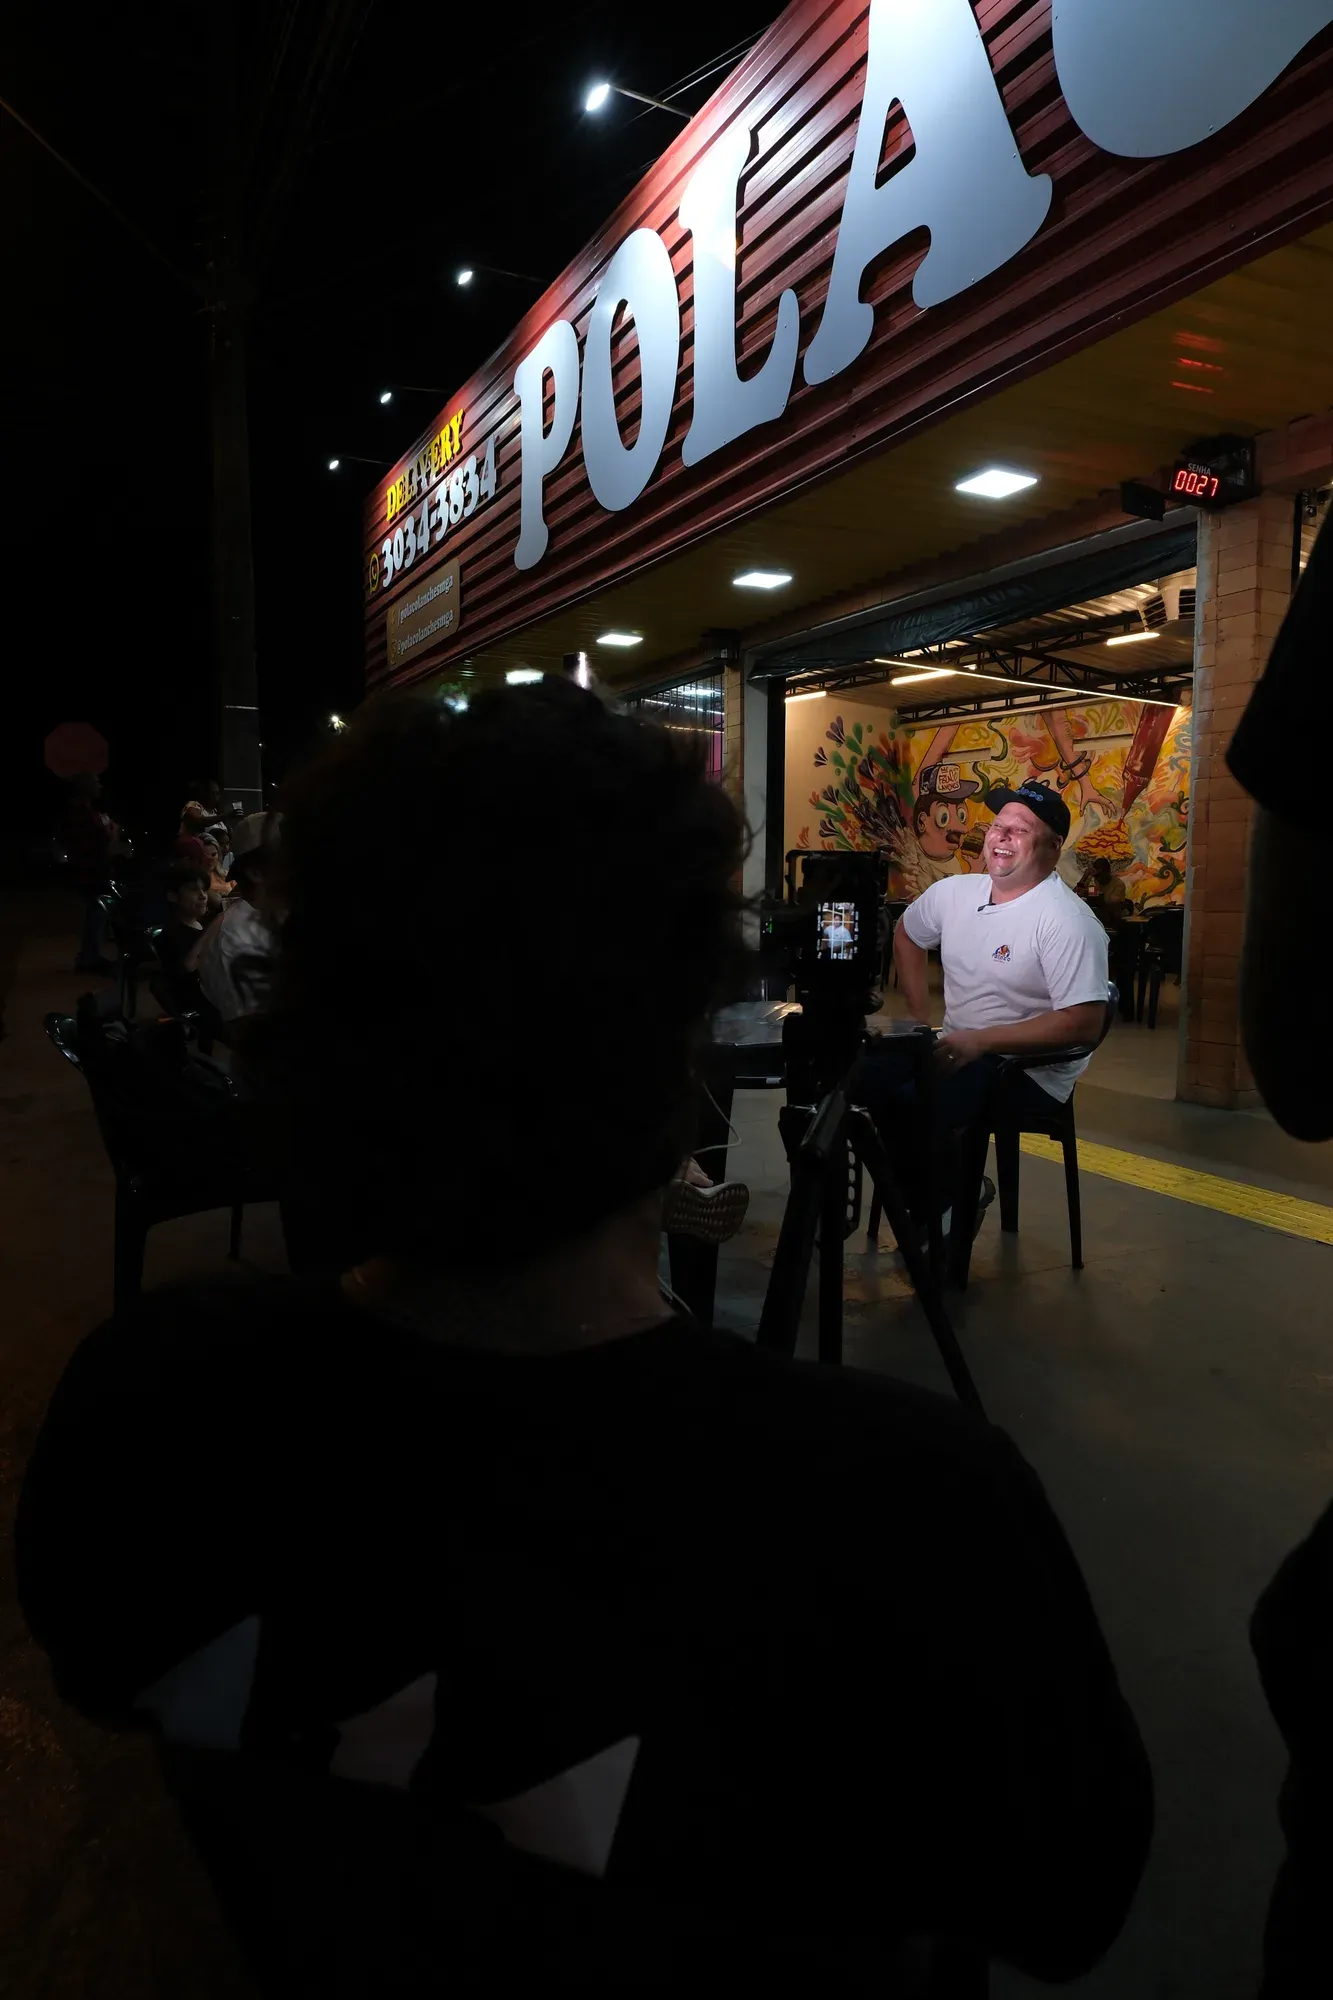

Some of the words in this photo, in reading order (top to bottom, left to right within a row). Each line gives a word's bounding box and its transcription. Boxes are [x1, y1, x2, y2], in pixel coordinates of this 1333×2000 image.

[386, 408, 464, 522] DELIVERY
[1174, 470, 1219, 497] 0027
[1187, 462, 1211, 476] SENHA
[382, 433, 497, 588] 3034-3834
